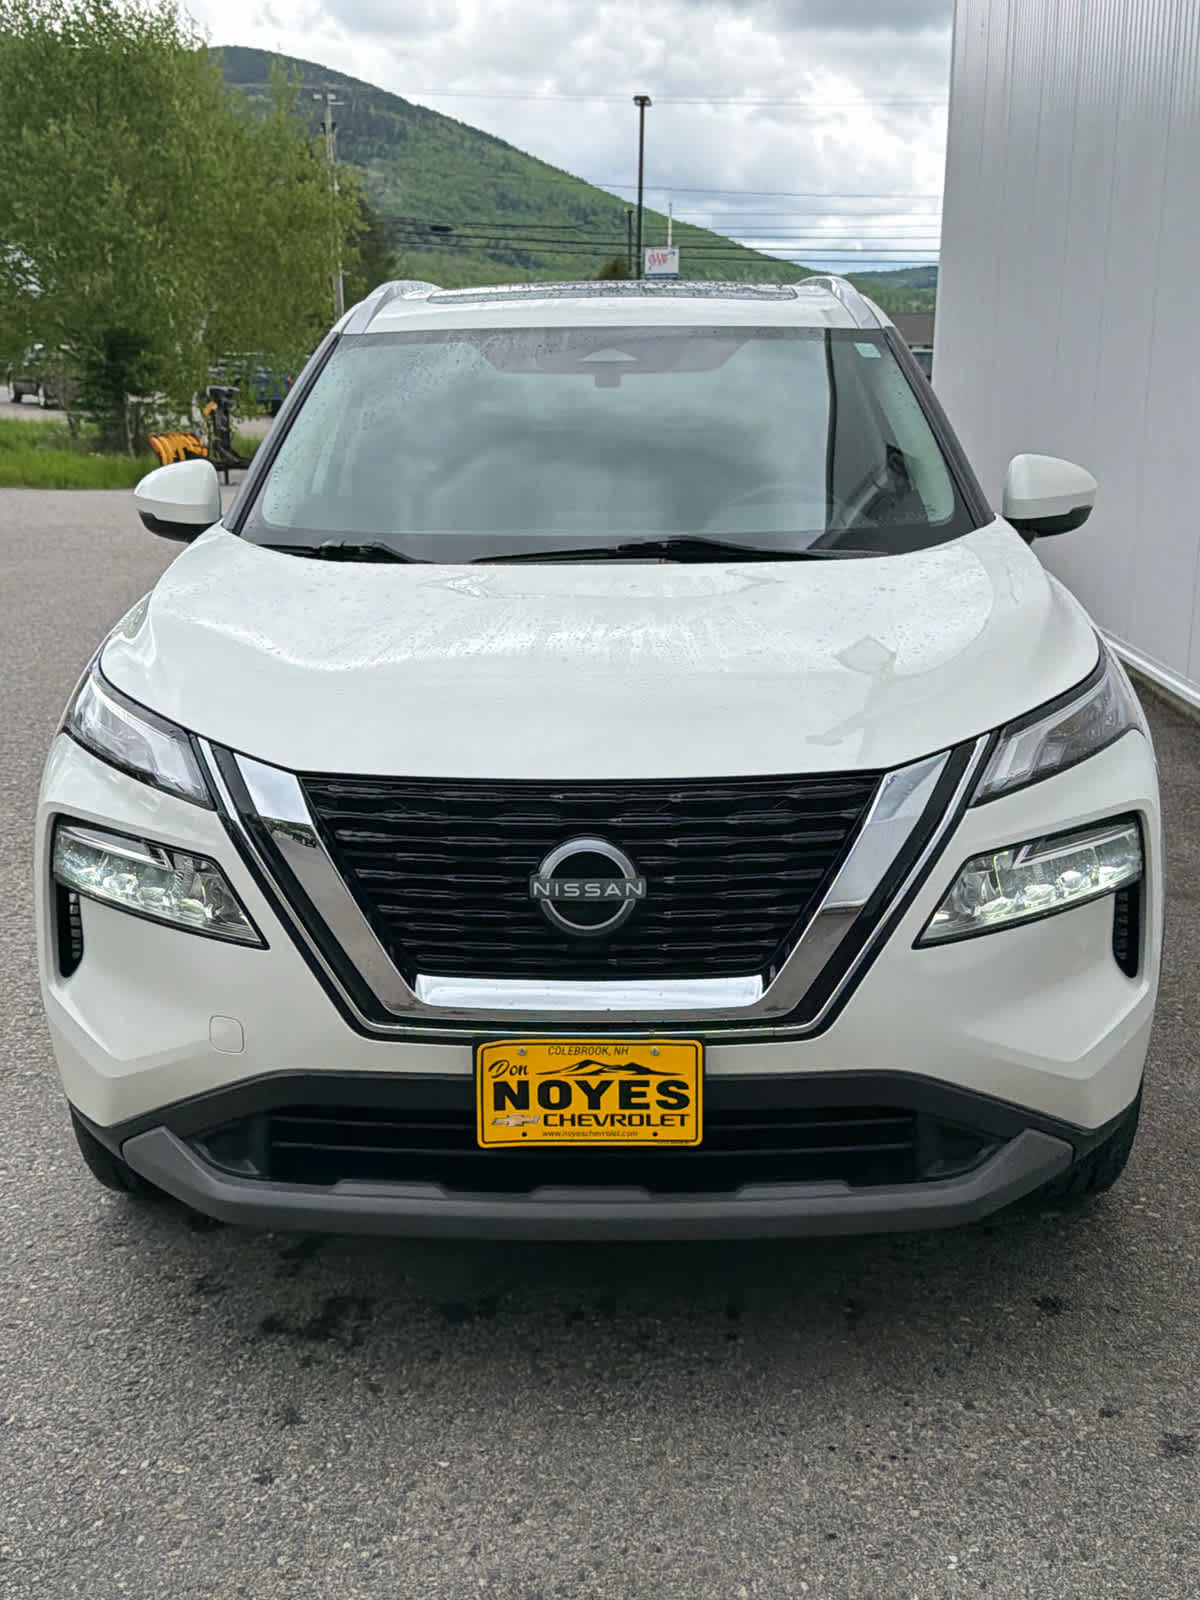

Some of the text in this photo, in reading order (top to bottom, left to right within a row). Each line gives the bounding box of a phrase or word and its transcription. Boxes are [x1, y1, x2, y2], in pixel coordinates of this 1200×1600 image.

[533, 882, 642, 897] NISSAN
[547, 1046, 629, 1056] COLEBROOK, NH
[488, 1059, 530, 1079] Don
[493, 1080, 690, 1111] NOYES
[543, 1113, 690, 1127] CHEVROLET
